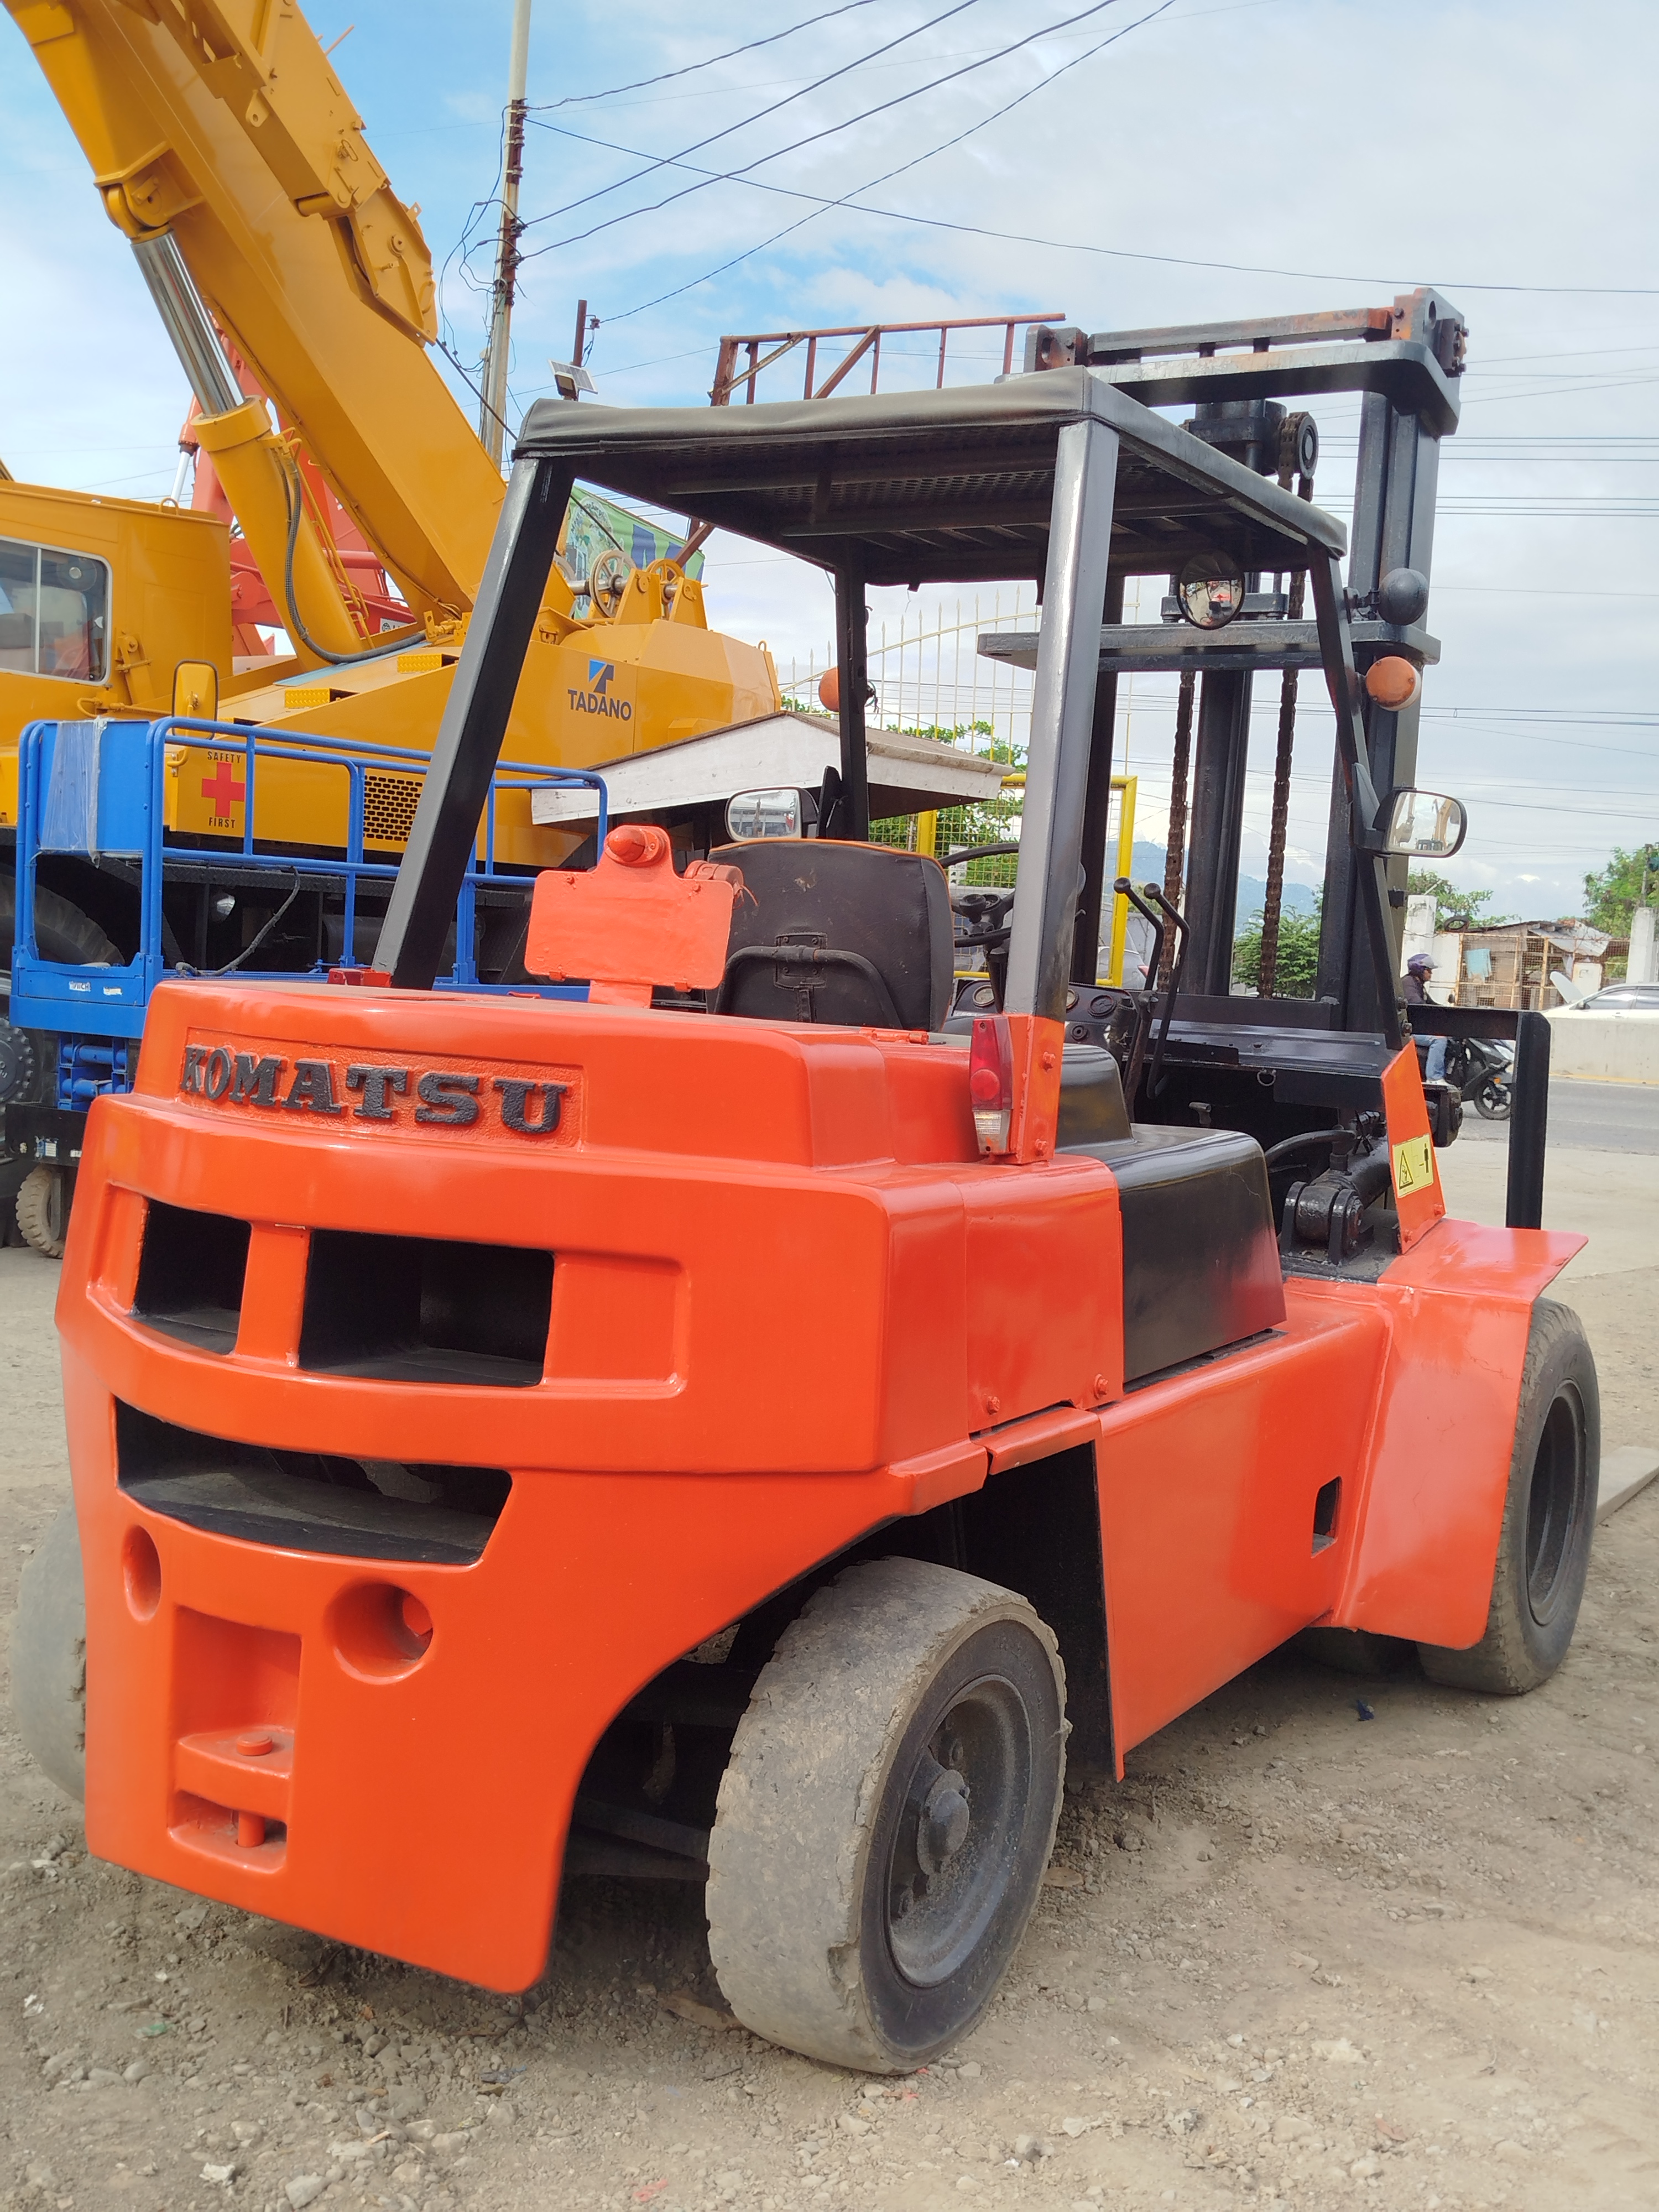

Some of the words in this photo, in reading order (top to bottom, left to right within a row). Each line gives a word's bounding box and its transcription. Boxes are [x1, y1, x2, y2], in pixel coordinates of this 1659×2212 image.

[567, 689, 632, 721] TADANO
[207, 751, 241, 763] SAFETY
[208, 817, 236, 828] FIRST
[180, 1045, 568, 1135] KOMATSU
